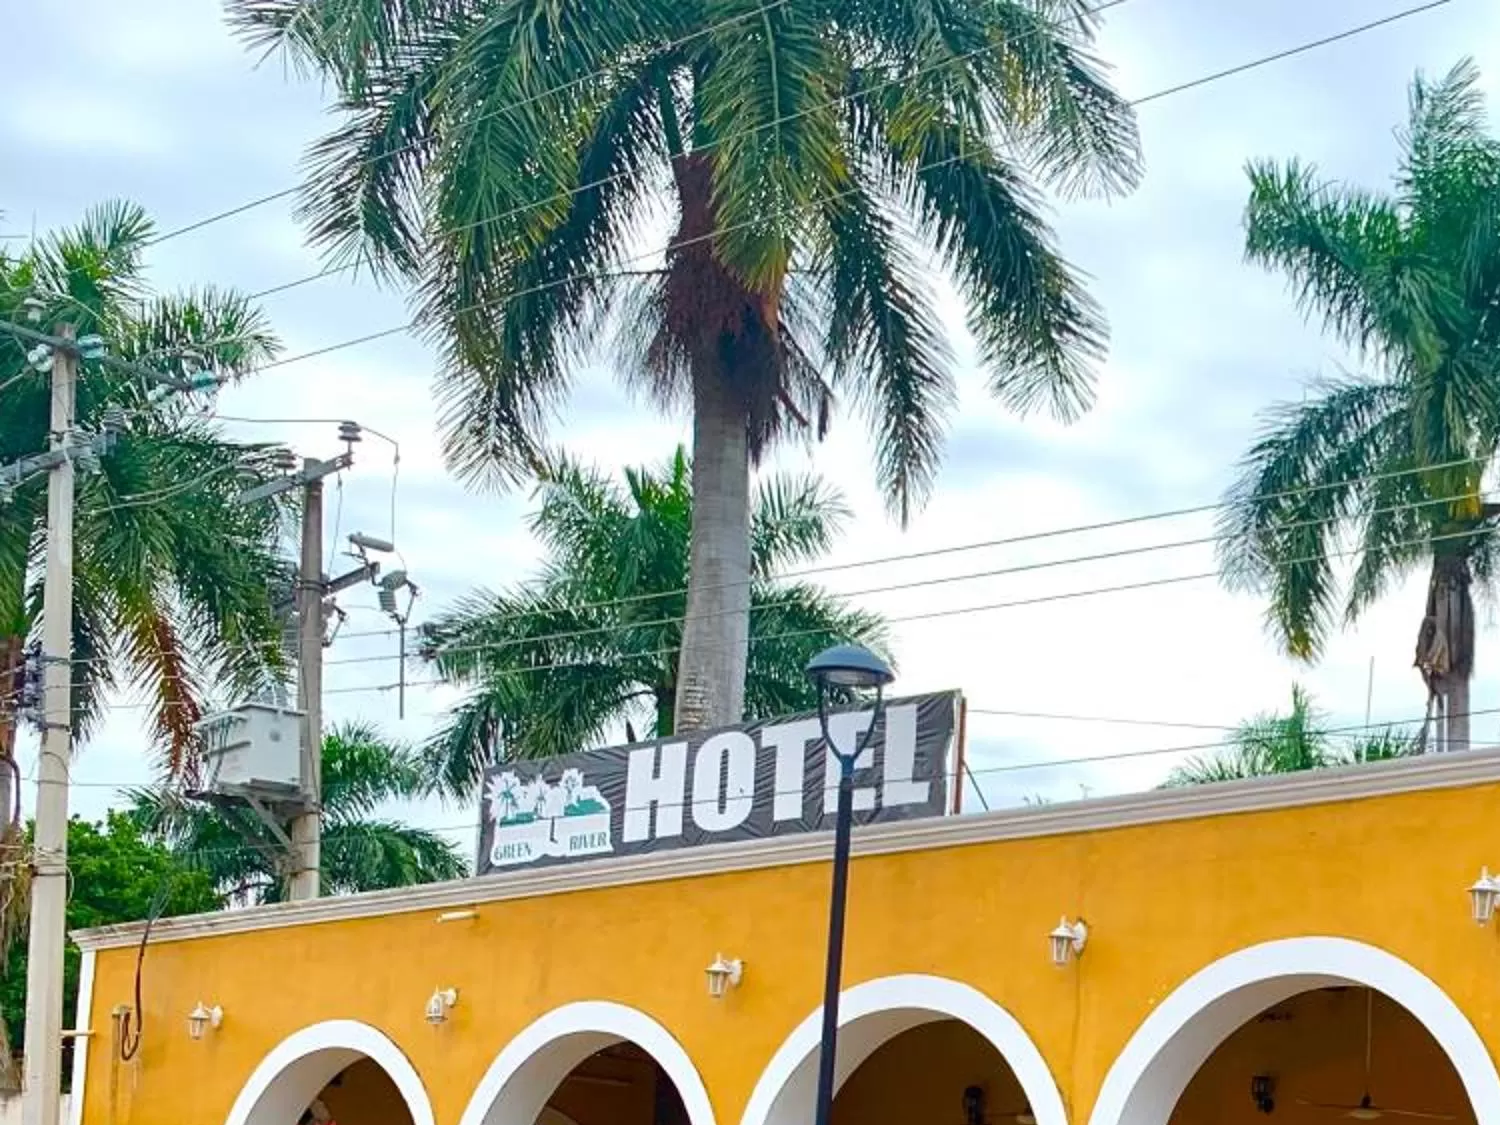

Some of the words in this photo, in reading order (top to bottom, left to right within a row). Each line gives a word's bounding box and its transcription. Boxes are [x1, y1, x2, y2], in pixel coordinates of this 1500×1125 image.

[623, 705, 930, 843] HOTEL
[495, 842, 532, 860] GREEN
[570, 832, 607, 851] RIVER
